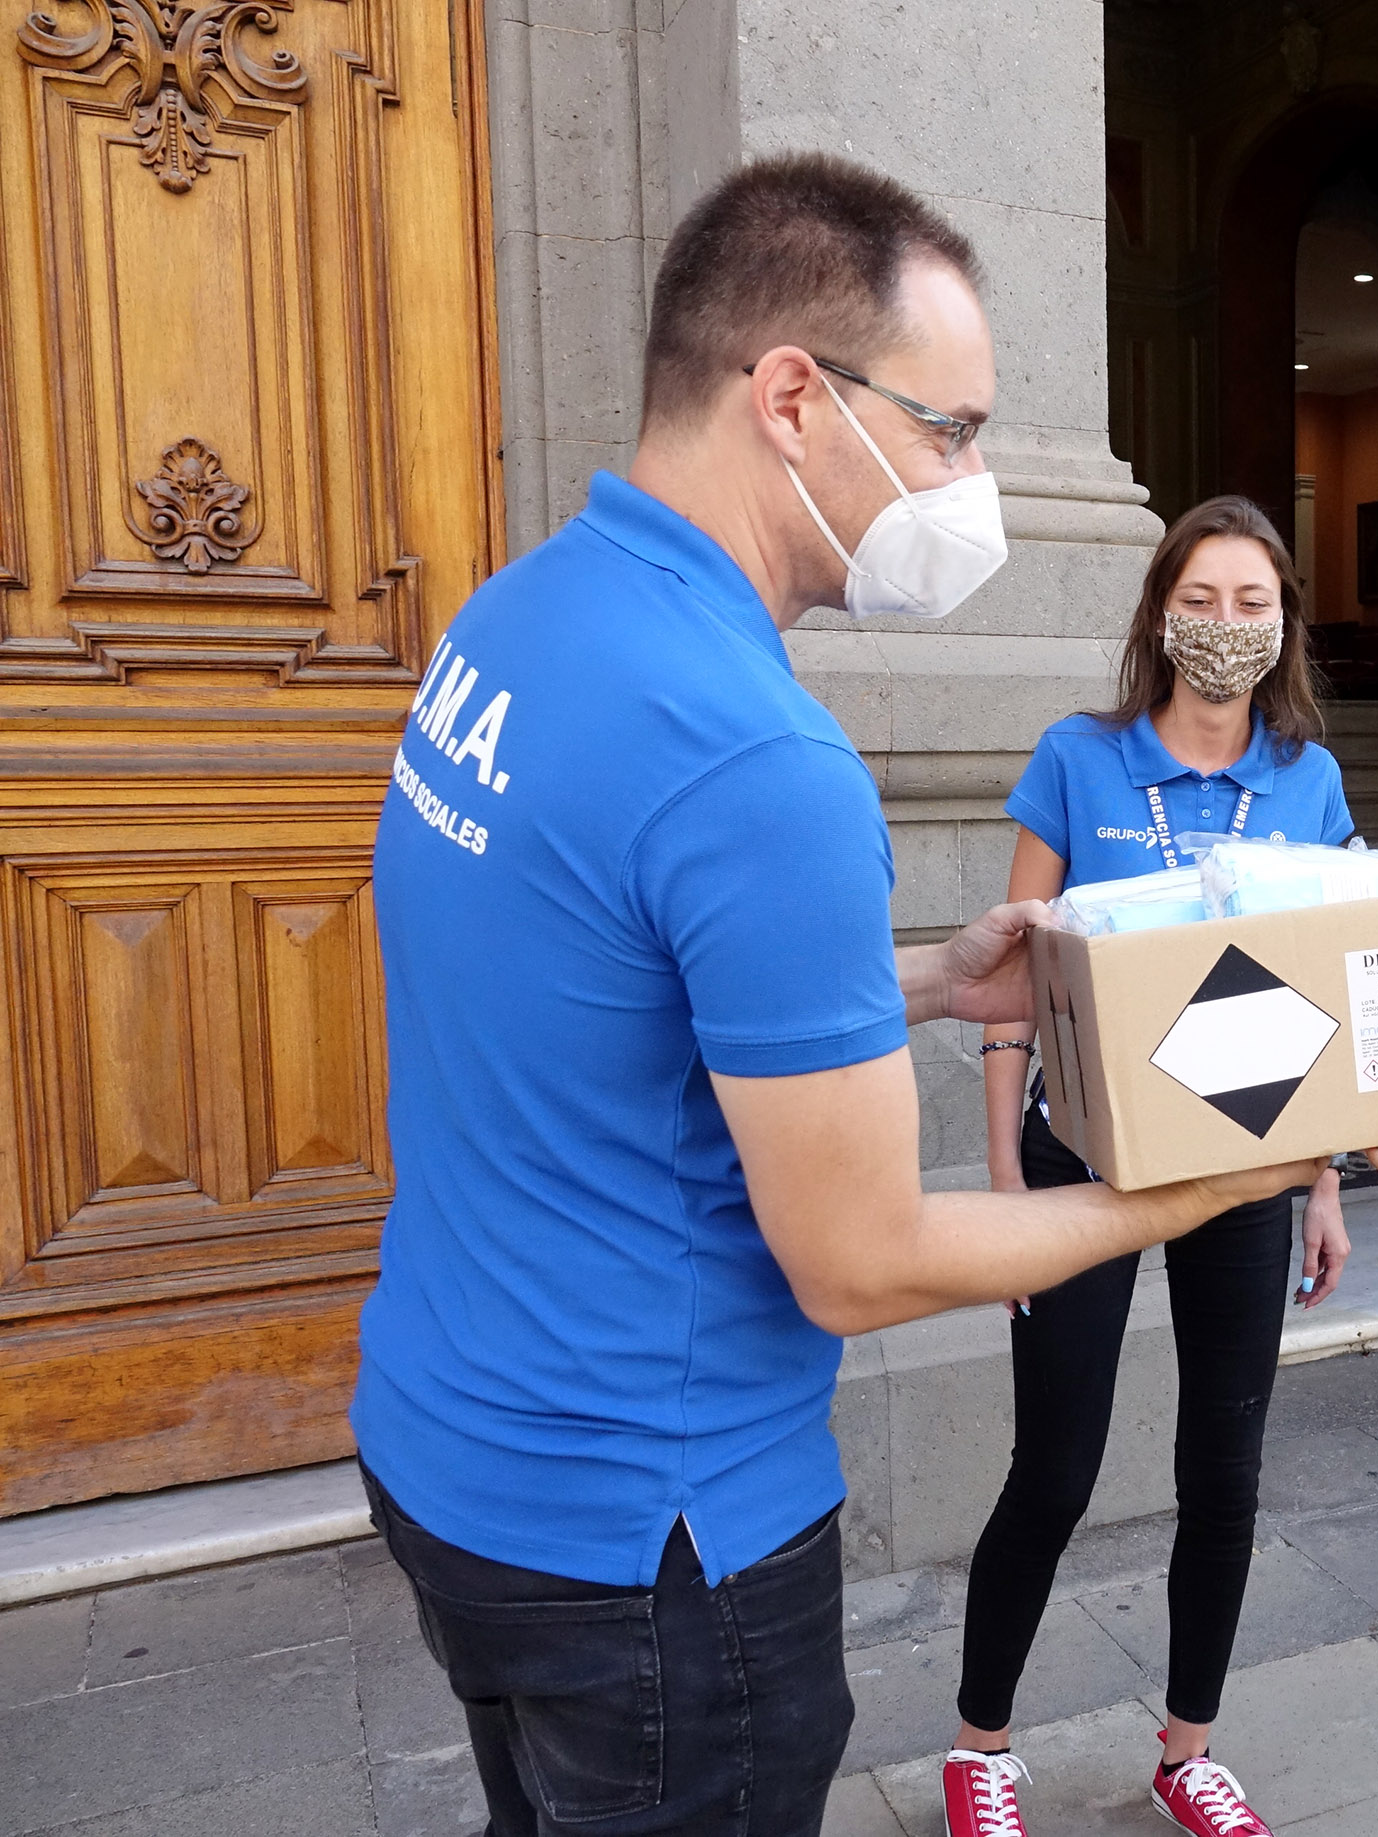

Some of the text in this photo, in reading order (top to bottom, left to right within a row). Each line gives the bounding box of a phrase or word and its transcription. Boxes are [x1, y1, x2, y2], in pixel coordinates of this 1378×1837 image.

[413, 782, 488, 855] SOCIALES
[1146, 786, 1178, 868] RGENCIA SO
